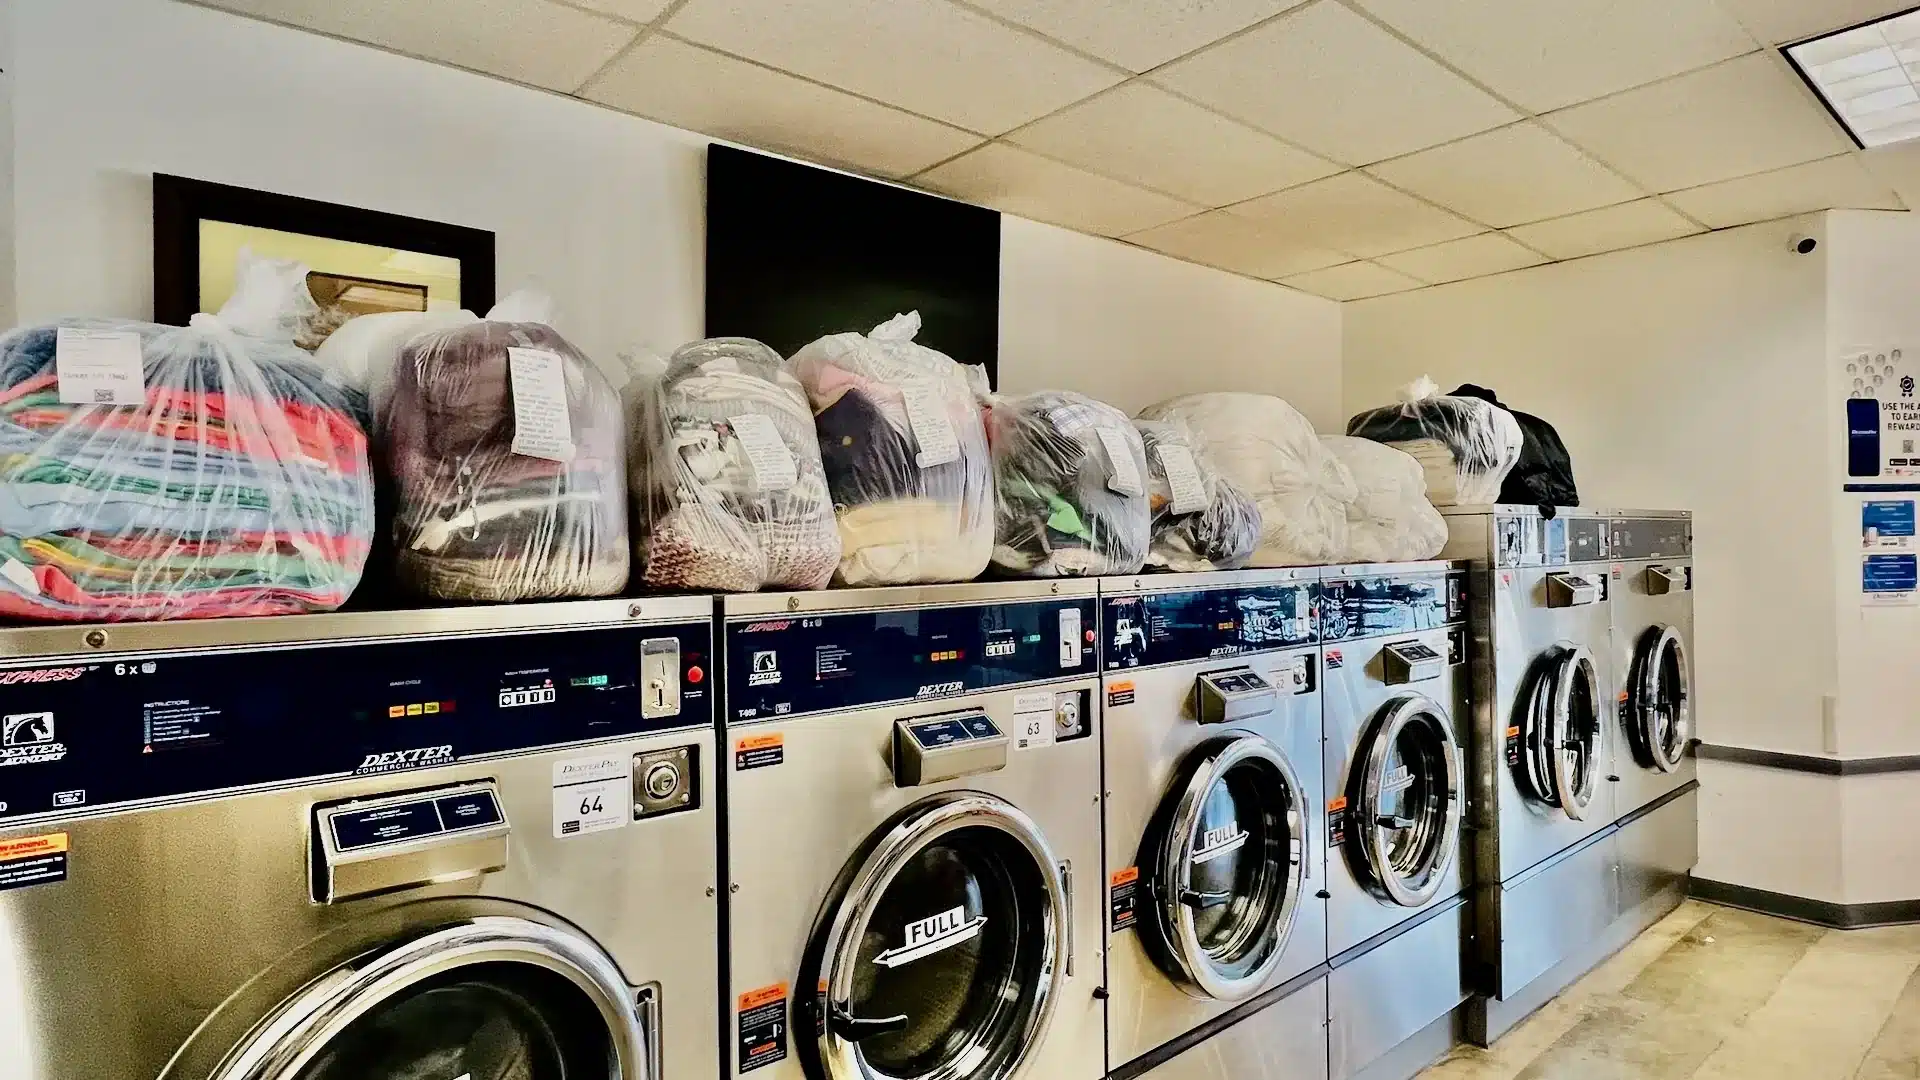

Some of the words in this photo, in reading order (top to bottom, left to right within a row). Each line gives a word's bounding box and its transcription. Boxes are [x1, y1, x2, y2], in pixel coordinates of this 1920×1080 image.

[1882, 403, 1898, 411] USE
[1900, 403, 1915, 411] THE
[1891, 413, 1902, 421] TO
[802, 619, 808, 628] 6
[1210, 645, 1238, 656] DEXTER
[115, 664, 126, 676] 6
[129, 666, 138, 675] x
[749, 671, 781, 680] DEXTER
[917, 681, 963, 696] DEXTER
[1027, 722, 1040, 736] 63
[359, 745, 453, 767] DEXTER
[356, 761, 415, 775] COMMERCIAL
[419, 756, 455, 766] WASHER
[1385, 767, 1406, 784] FULL
[580, 795, 603, 815] 64
[1208, 824, 1235, 847] FULL
[912, 912, 959, 943] FULL
